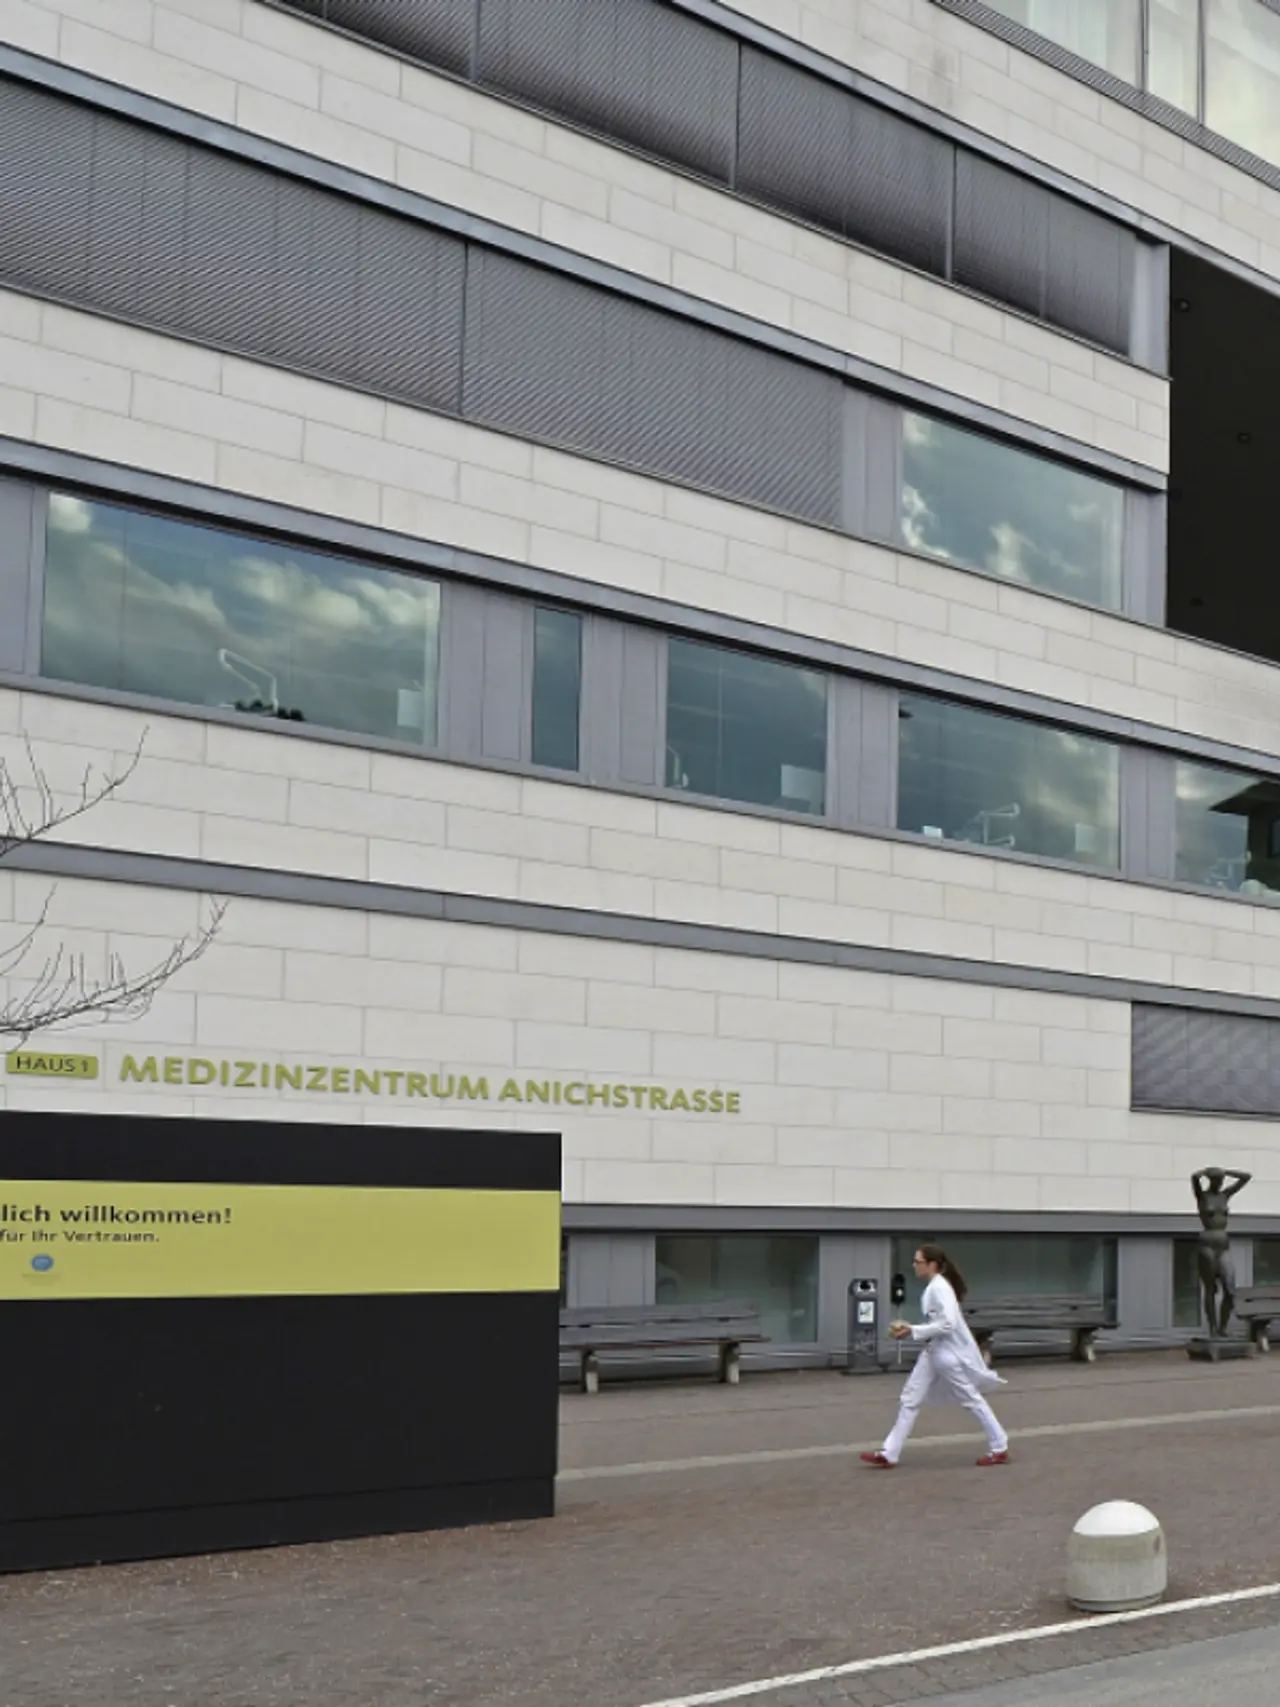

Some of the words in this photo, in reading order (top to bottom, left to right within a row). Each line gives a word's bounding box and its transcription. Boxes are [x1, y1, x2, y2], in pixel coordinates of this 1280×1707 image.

[16, 1055, 75, 1072] HAUS
[81, 1060, 89, 1073] 1
[119, 1054, 490, 1100] MEDIZINZENTRUM
[498, 1078, 741, 1114] ANICHSTRASSE
[60, 1205, 232, 1224] willkommen!
[32, 1230, 57, 1242] Ihr
[62, 1231, 160, 1243] Vertrauen.
